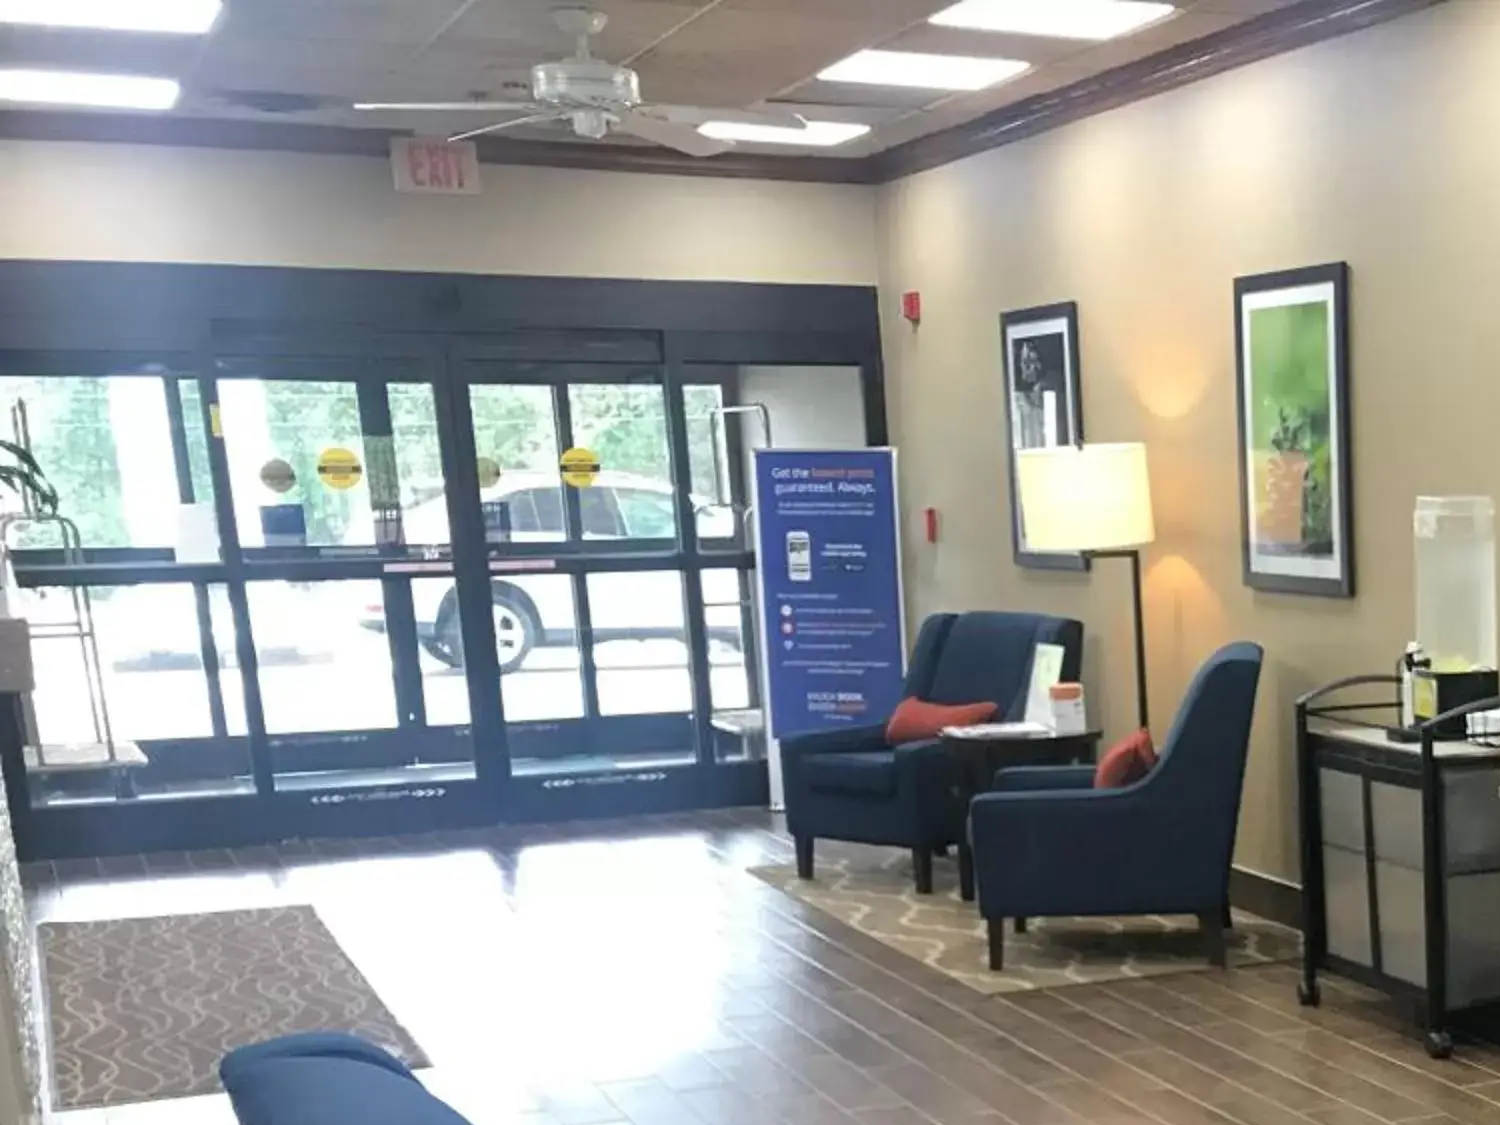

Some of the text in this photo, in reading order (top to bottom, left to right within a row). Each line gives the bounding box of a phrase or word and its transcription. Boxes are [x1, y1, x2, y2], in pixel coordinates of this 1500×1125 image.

[407, 141, 467, 190] EXIT
[771, 467, 791, 479] Get
[791, 467, 810, 479] the
